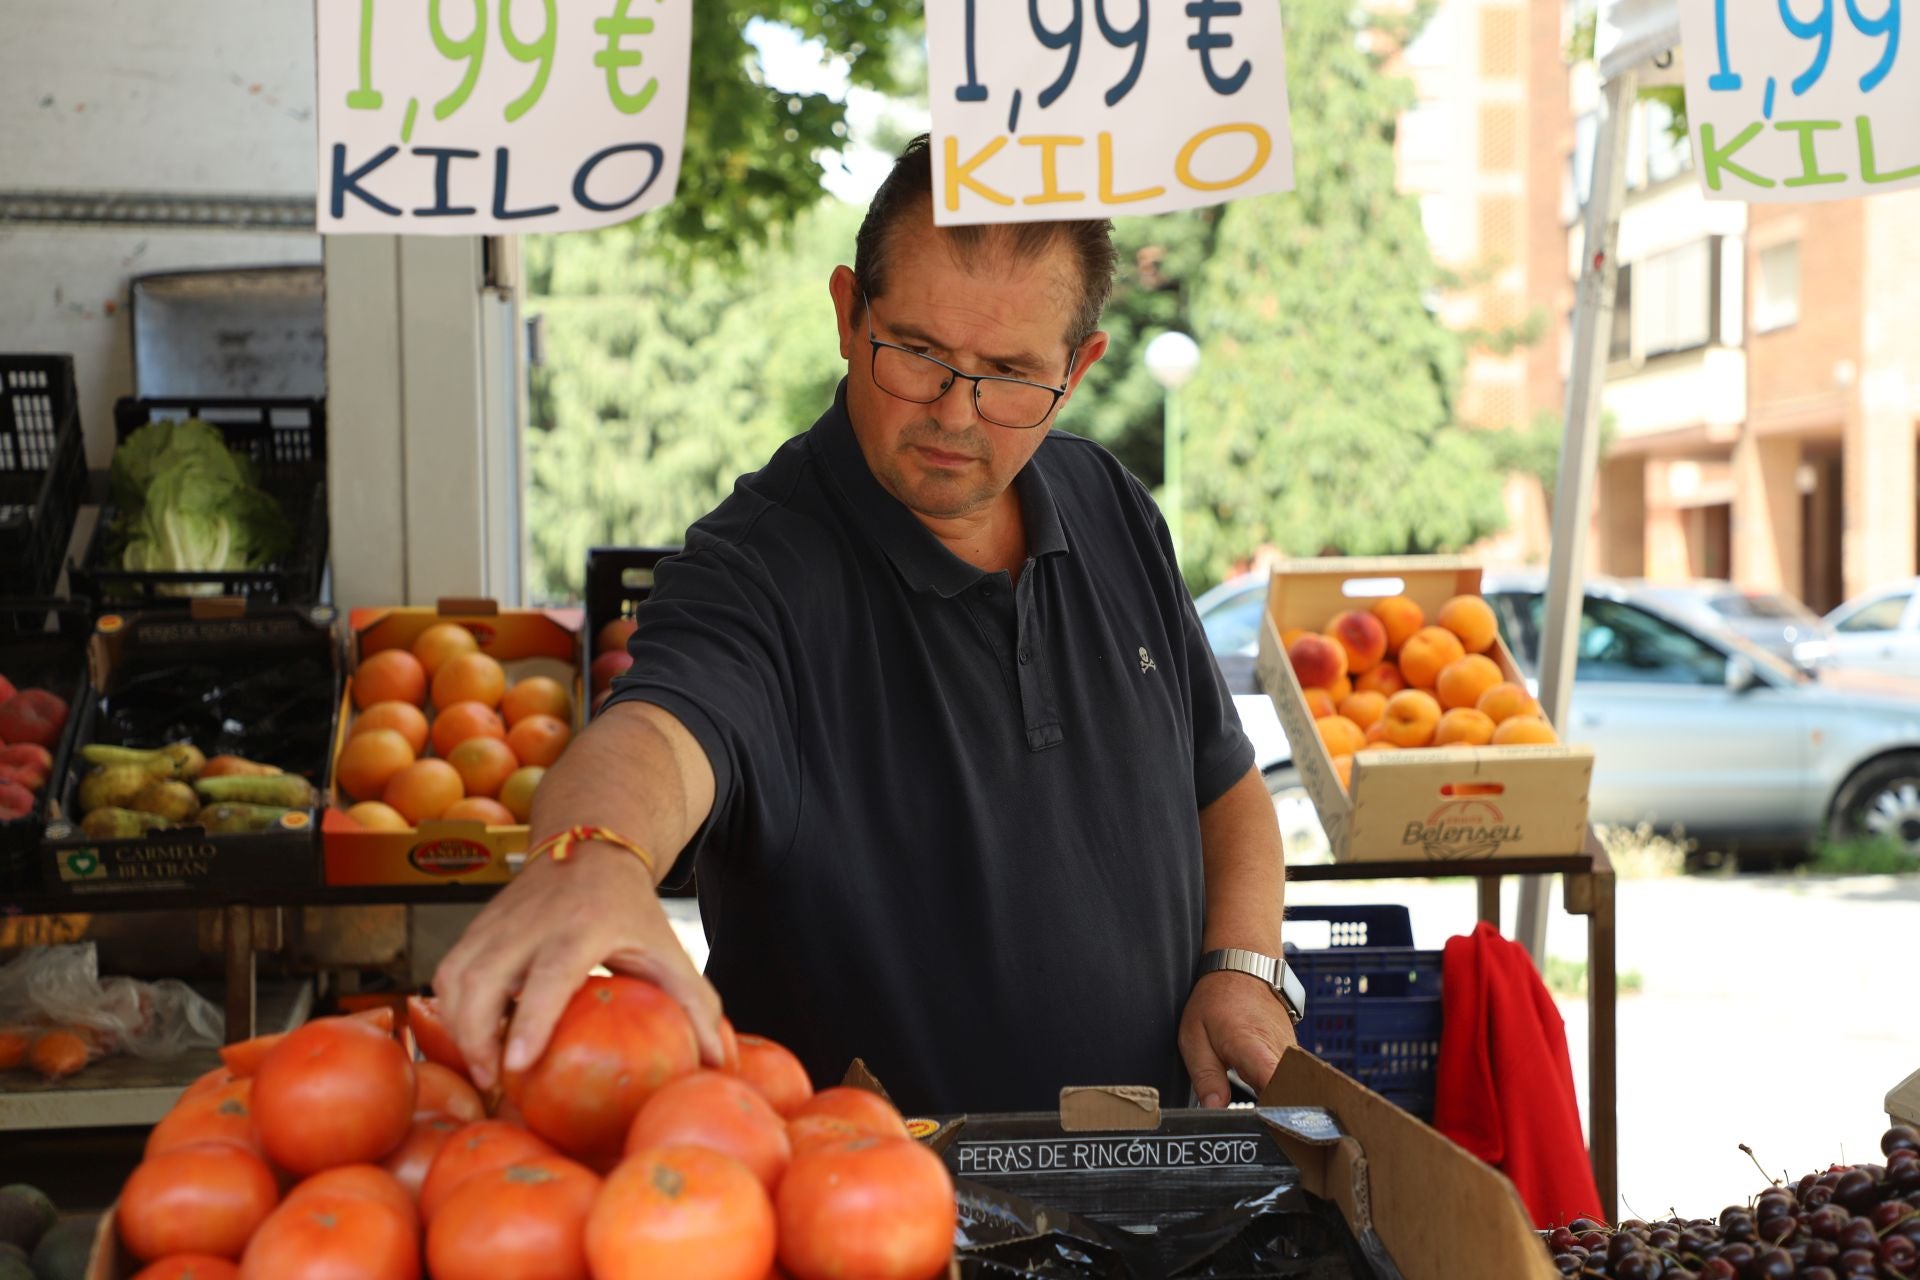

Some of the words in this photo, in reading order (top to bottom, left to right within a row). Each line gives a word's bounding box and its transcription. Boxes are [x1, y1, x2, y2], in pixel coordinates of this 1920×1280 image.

[345, 0, 557, 143] 1,99
[593, 0, 658, 114] €
[954, 0, 1149, 133] 1,99
[1185, 0, 1252, 96] €
[1707, 0, 1902, 120] 1,99
[330, 142, 664, 219] KILO
[943, 122, 1272, 212] KILO
[1700, 115, 1920, 191] KIL
[115, 843, 217, 862] CARMELO
[1402, 820, 1524, 846] Belenseu
[957, 1145, 1032, 1173] PERAS
[1039, 1144, 1068, 1168] DE
[1072, 1138, 1160, 1170] RINCÓN
[1167, 1141, 1196, 1165] DE
[1200, 1140, 1259, 1164] SOTO
